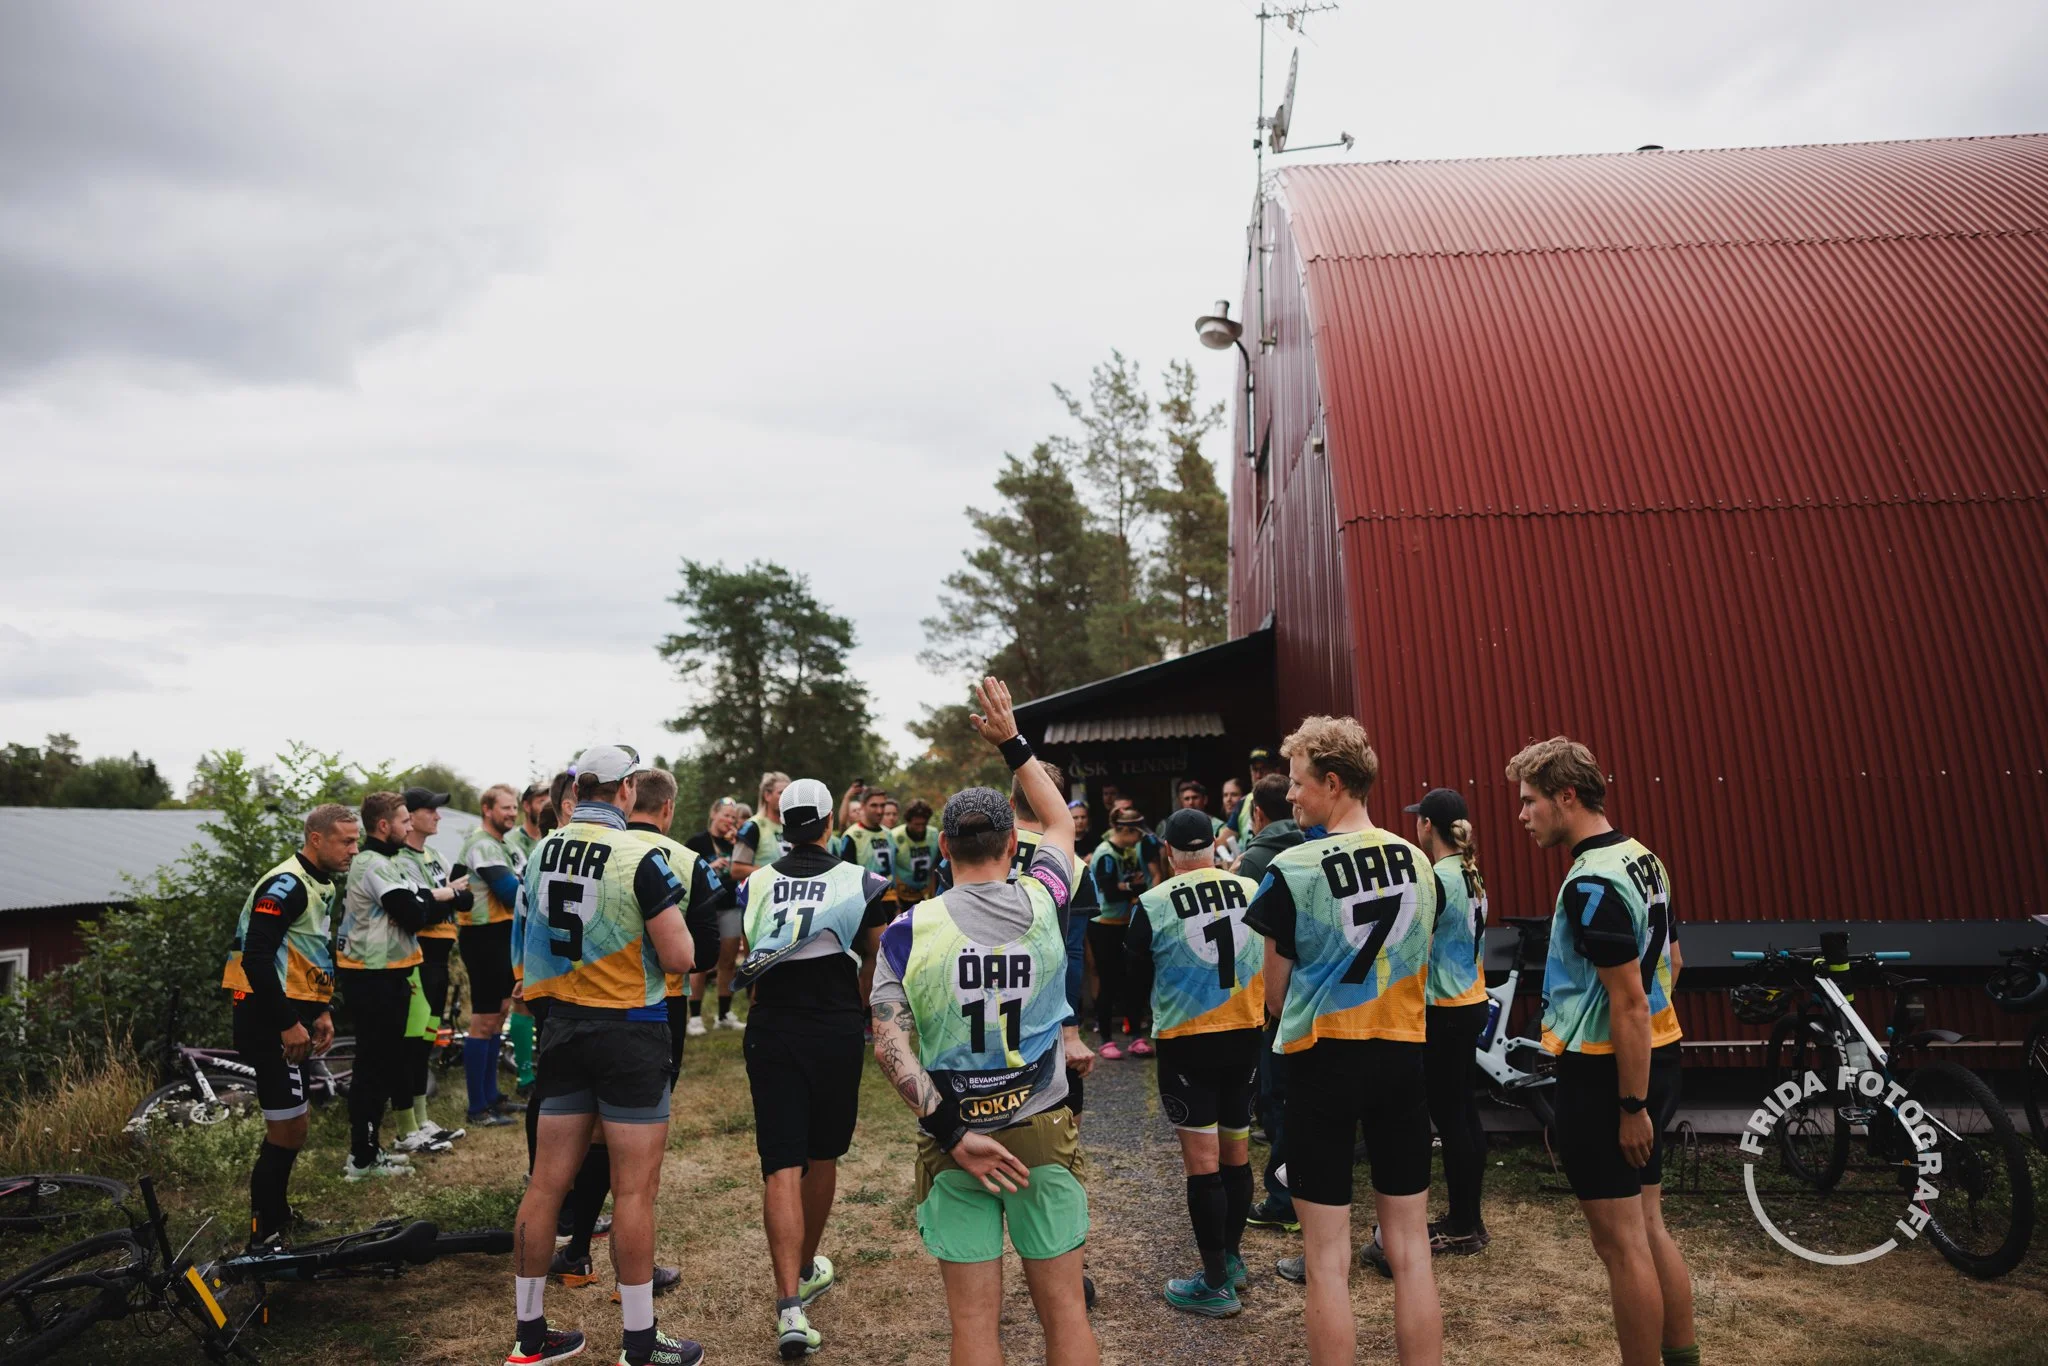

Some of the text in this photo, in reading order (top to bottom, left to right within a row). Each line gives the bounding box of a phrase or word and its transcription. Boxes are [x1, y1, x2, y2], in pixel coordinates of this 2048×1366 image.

[540, 833, 612, 880] ÖAR
[1320, 843, 1417, 899] ÖAR
[1621, 853, 1665, 904] ÖAR
[266, 874, 297, 900] 2
[773, 877, 827, 904] ÖAR
[1170, 880, 1248, 919] ÖAR
[1576, 882, 1605, 926] 7
[548, 880, 584, 962] 5
[769, 907, 815, 940] 11
[1340, 892, 1403, 984] 7
[958, 948, 1031, 989] ÖAR
[1202, 915, 1235, 989] 1
[1640, 902, 1667, 995] 7
[961, 998, 1022, 1054] 11
[650, 1350, 682, 1364] HOKA
